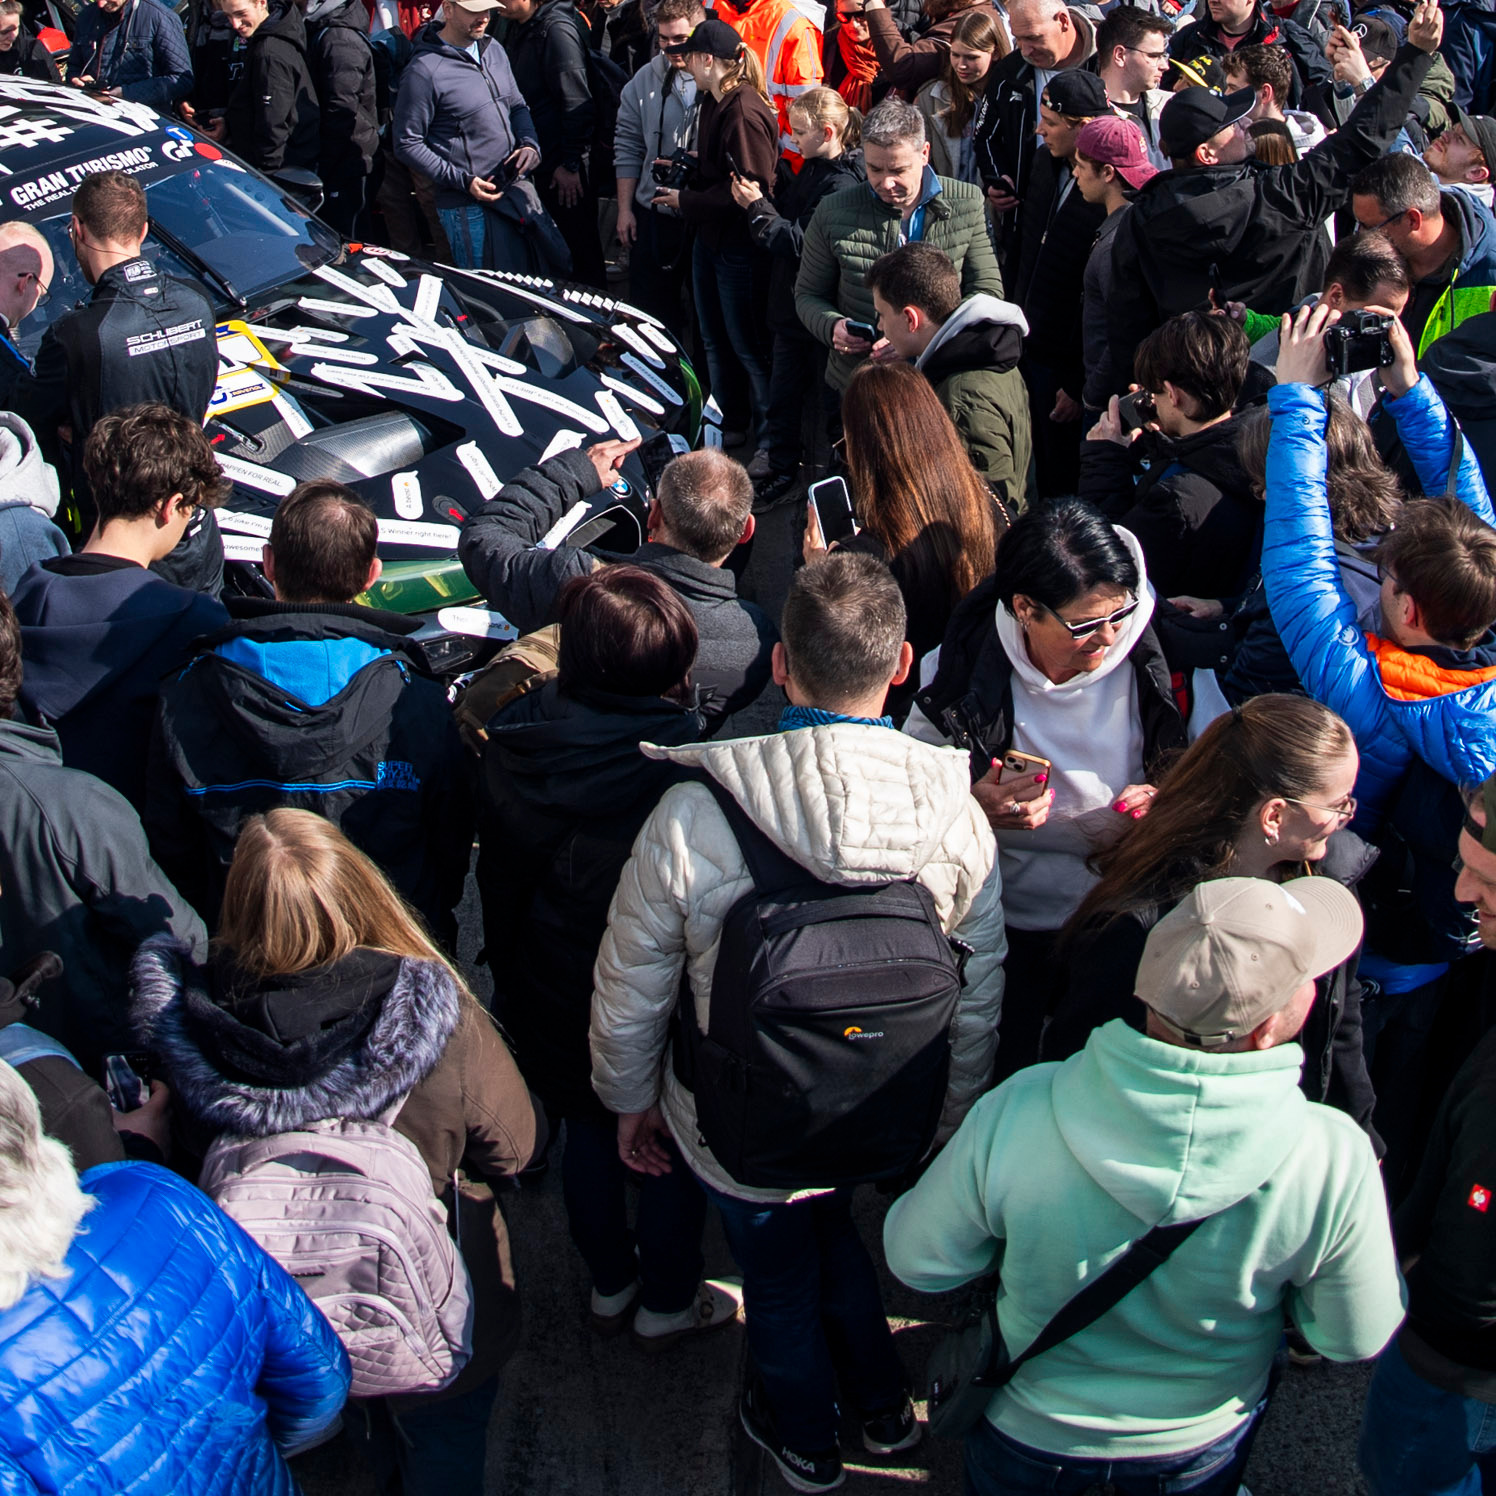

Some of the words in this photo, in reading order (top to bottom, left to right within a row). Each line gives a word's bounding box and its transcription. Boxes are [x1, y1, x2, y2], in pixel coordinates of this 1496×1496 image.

[10, 171, 69, 206] GRAN
[66, 147, 151, 185] TURISMO
[22, 201, 46, 212] THE
[46, 189, 70, 203] REAL
[122, 161, 159, 176] ULATOR
[125, 319, 203, 346] SCHUBERT
[134, 331, 203, 354] MOTORSPORT
[247, 470, 263, 482] FOR
[848, 1030, 884, 1041] lowepro
[781, 1445, 816, 1474] HOKA
